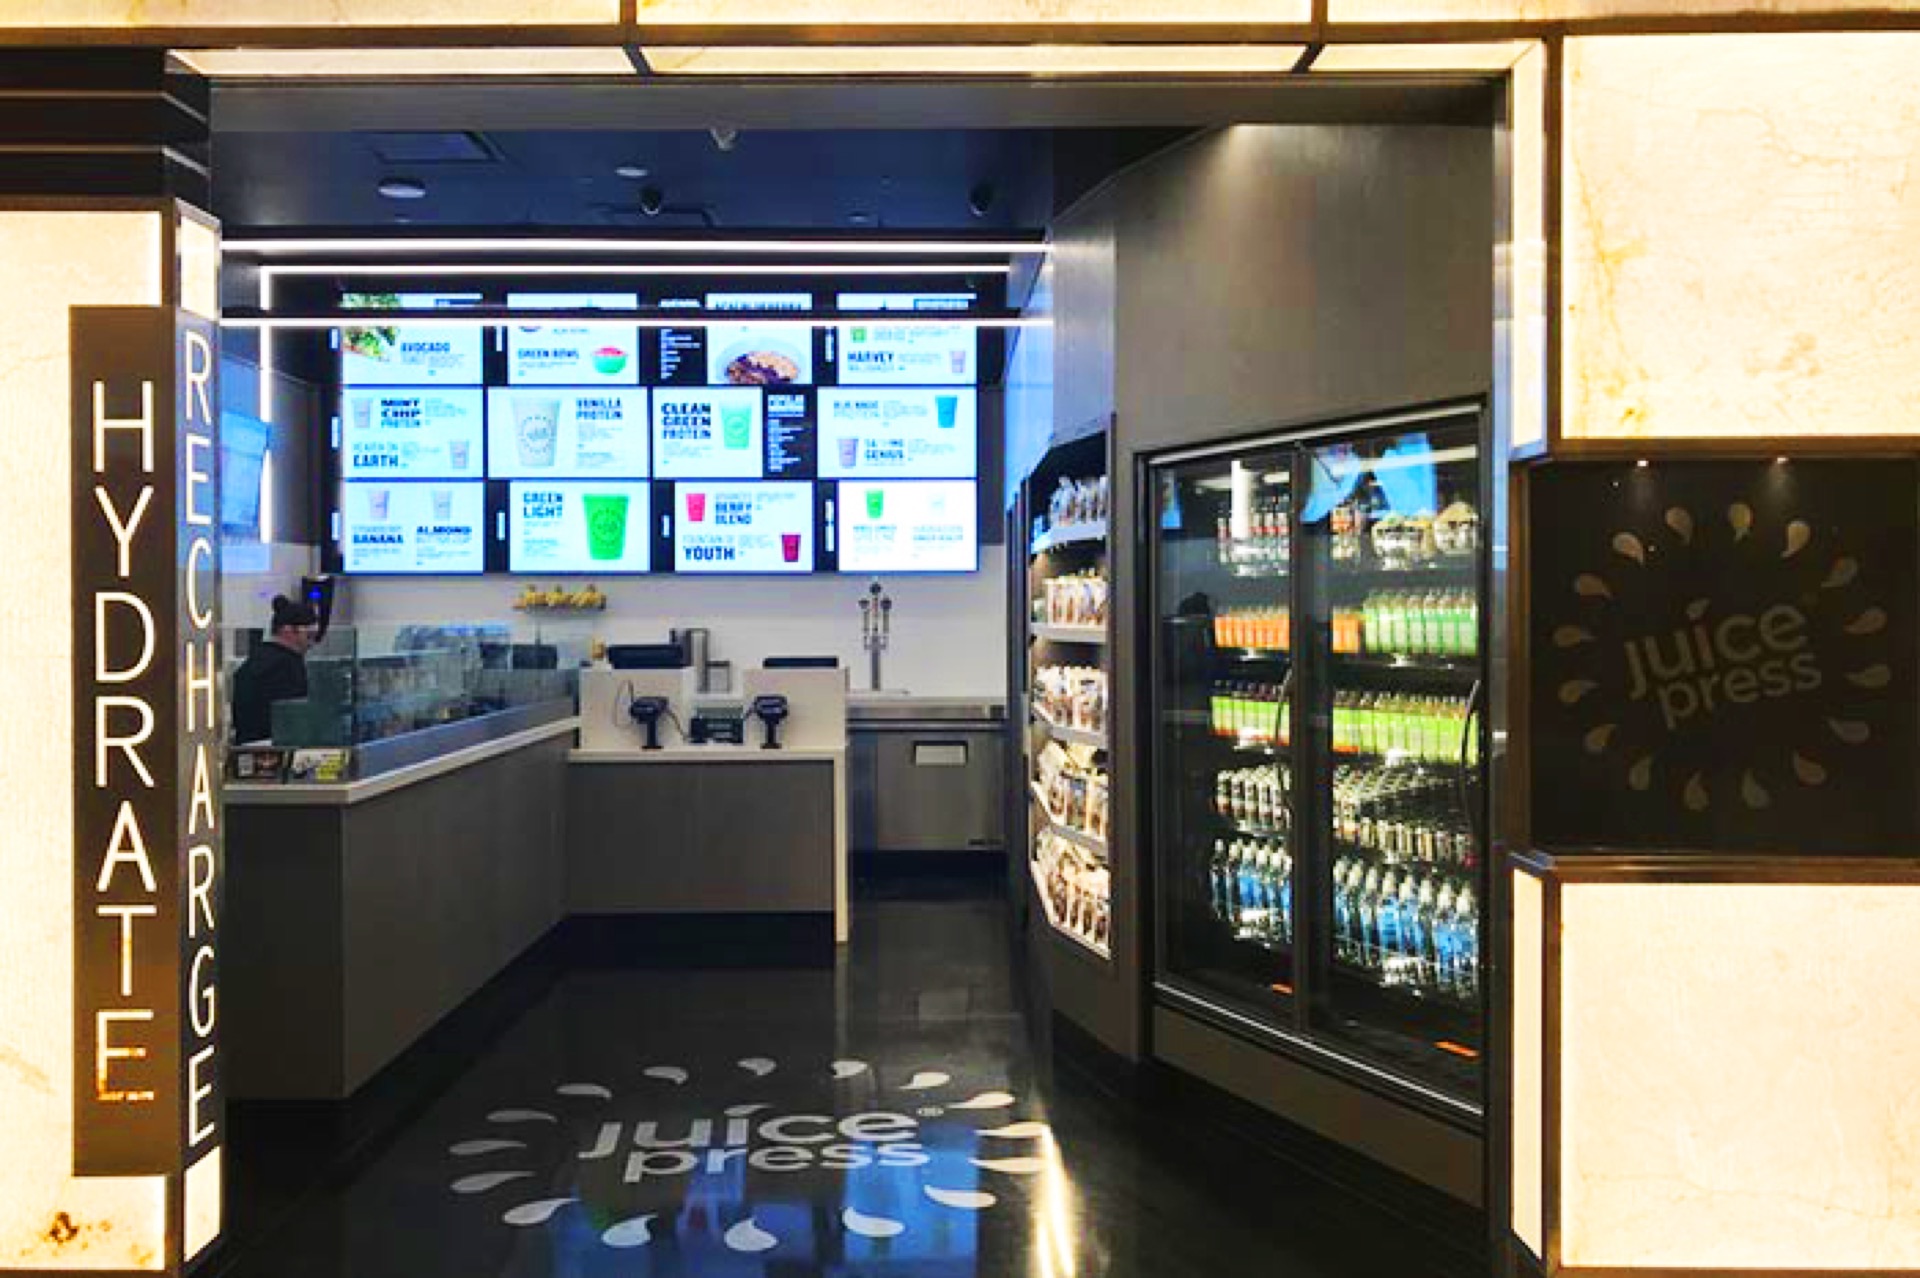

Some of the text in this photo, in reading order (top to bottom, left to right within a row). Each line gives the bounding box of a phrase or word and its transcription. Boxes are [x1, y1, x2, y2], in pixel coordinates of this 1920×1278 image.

[400, 342, 451, 353] AVOCADO
[847, 351, 895, 363] HARVEY
[661, 402, 711, 415] CLEAN
[576, 411, 622, 421] PROTEIN
[661, 416, 711, 427] GREEN
[661, 429, 711, 440] PROTEIN
[352, 454, 399, 468] EARTH
[523, 492, 564, 503] GREEN
[523, 505, 564, 518] LIGHT
[715, 502, 752, 513] BERRY
[715, 515, 752, 525] BLEND
[416, 526, 473, 536] ALMOND
[352, 534, 404, 544] BANANA
[683, 546, 736, 561] YOUTH
[1624, 599, 1809, 701] juice
[1657, 652, 1823, 730] press
[92, 380, 158, 1101] HYDRATE
[185, 330, 215, 1147] RECHARGE
[577, 1103, 919, 1160] juice
[622, 1140, 931, 1184] press
